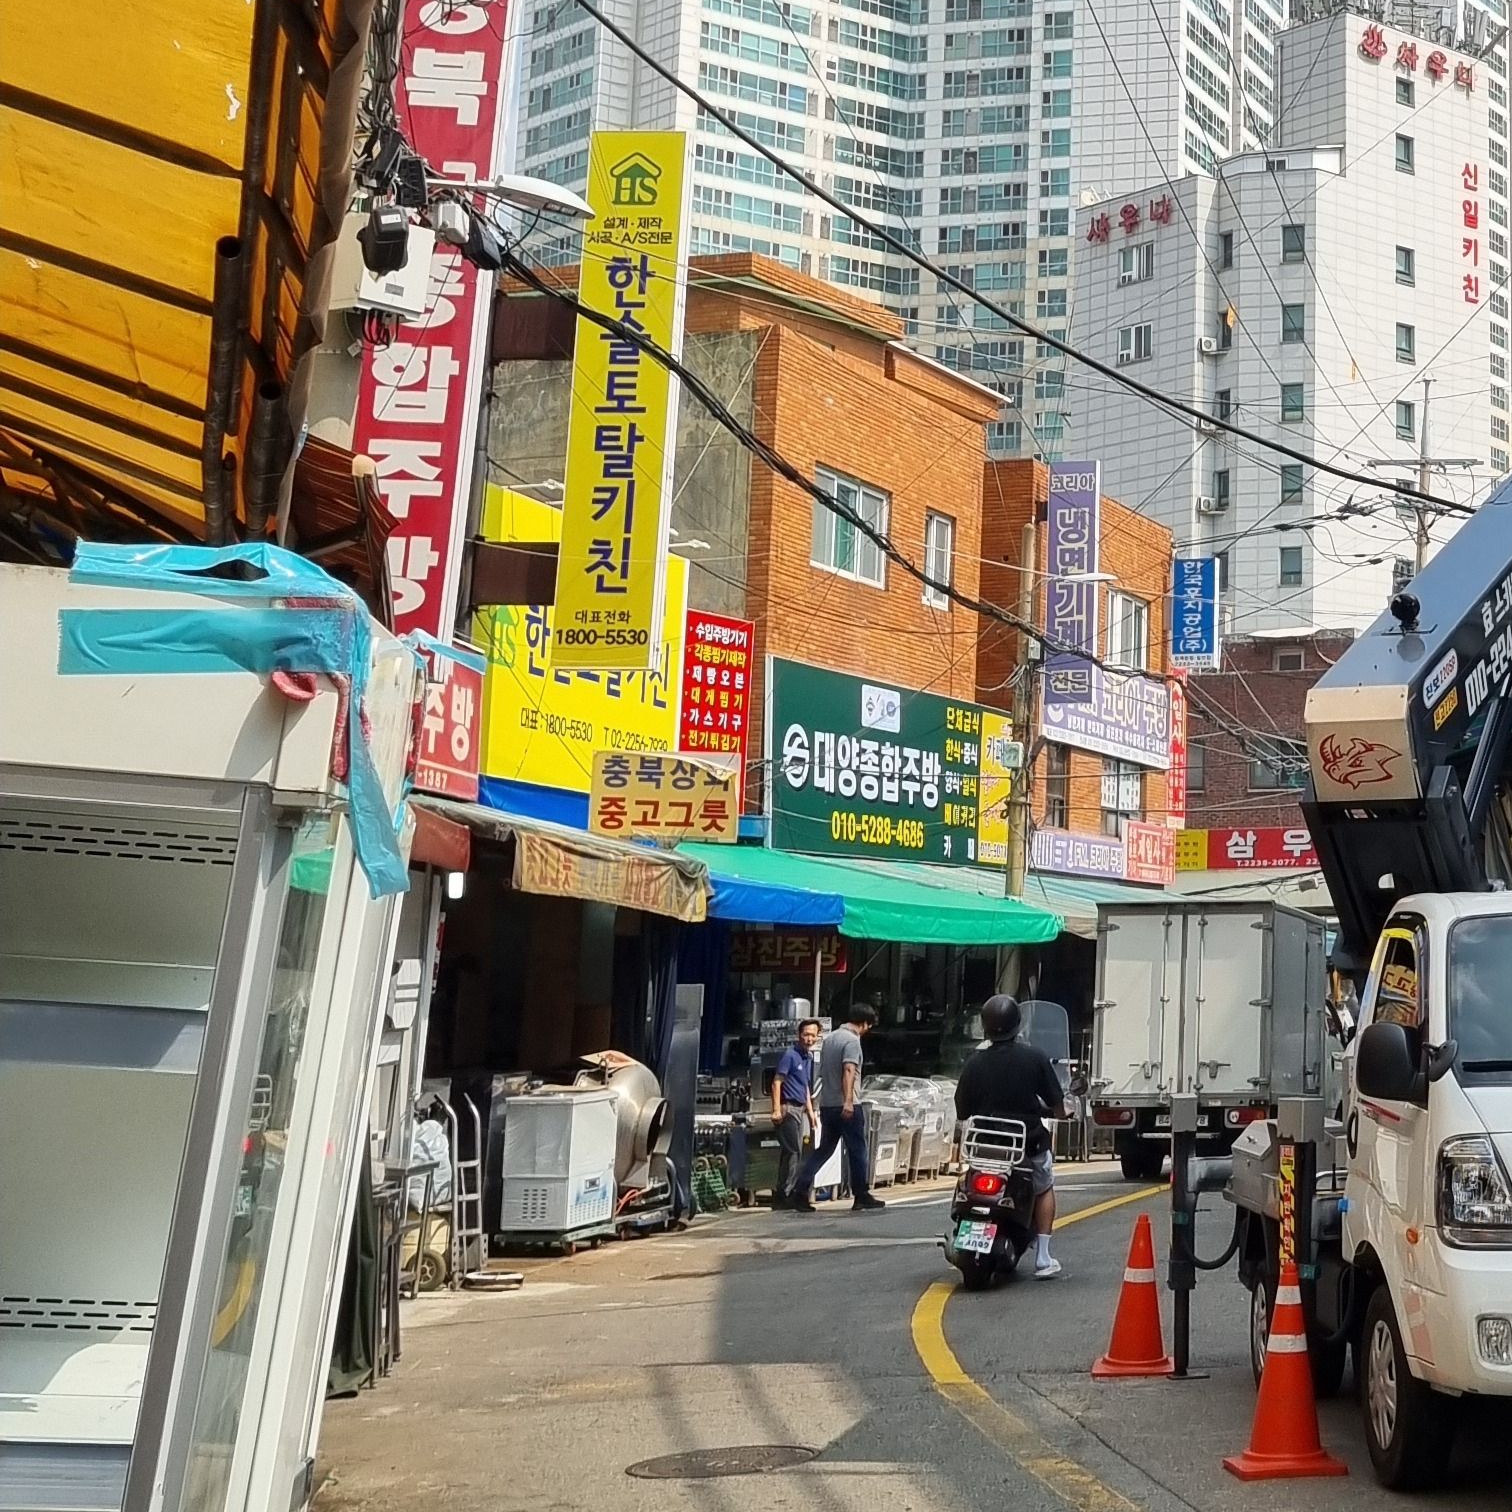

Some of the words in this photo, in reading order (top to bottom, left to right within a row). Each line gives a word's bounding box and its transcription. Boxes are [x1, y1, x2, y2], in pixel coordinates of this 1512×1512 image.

[585, 254, 656, 594] 한솔토탈키친
[1052, 474, 1095, 492] 코리아
[575, 610, 632, 625] 대표전화
[556, 629, 648, 645] 1800-5530
[695, 622, 747, 648] 수입주방기기
[1052, 669, 1089, 694] 전문
[946, 706, 979, 736] 단체급식
[814, 731, 941, 809] 대양종합주방
[598, 796, 729, 833] 중고그릇
[944, 802, 976, 829] 베이커리
[831, 811, 924, 849] 010-5288-4686
